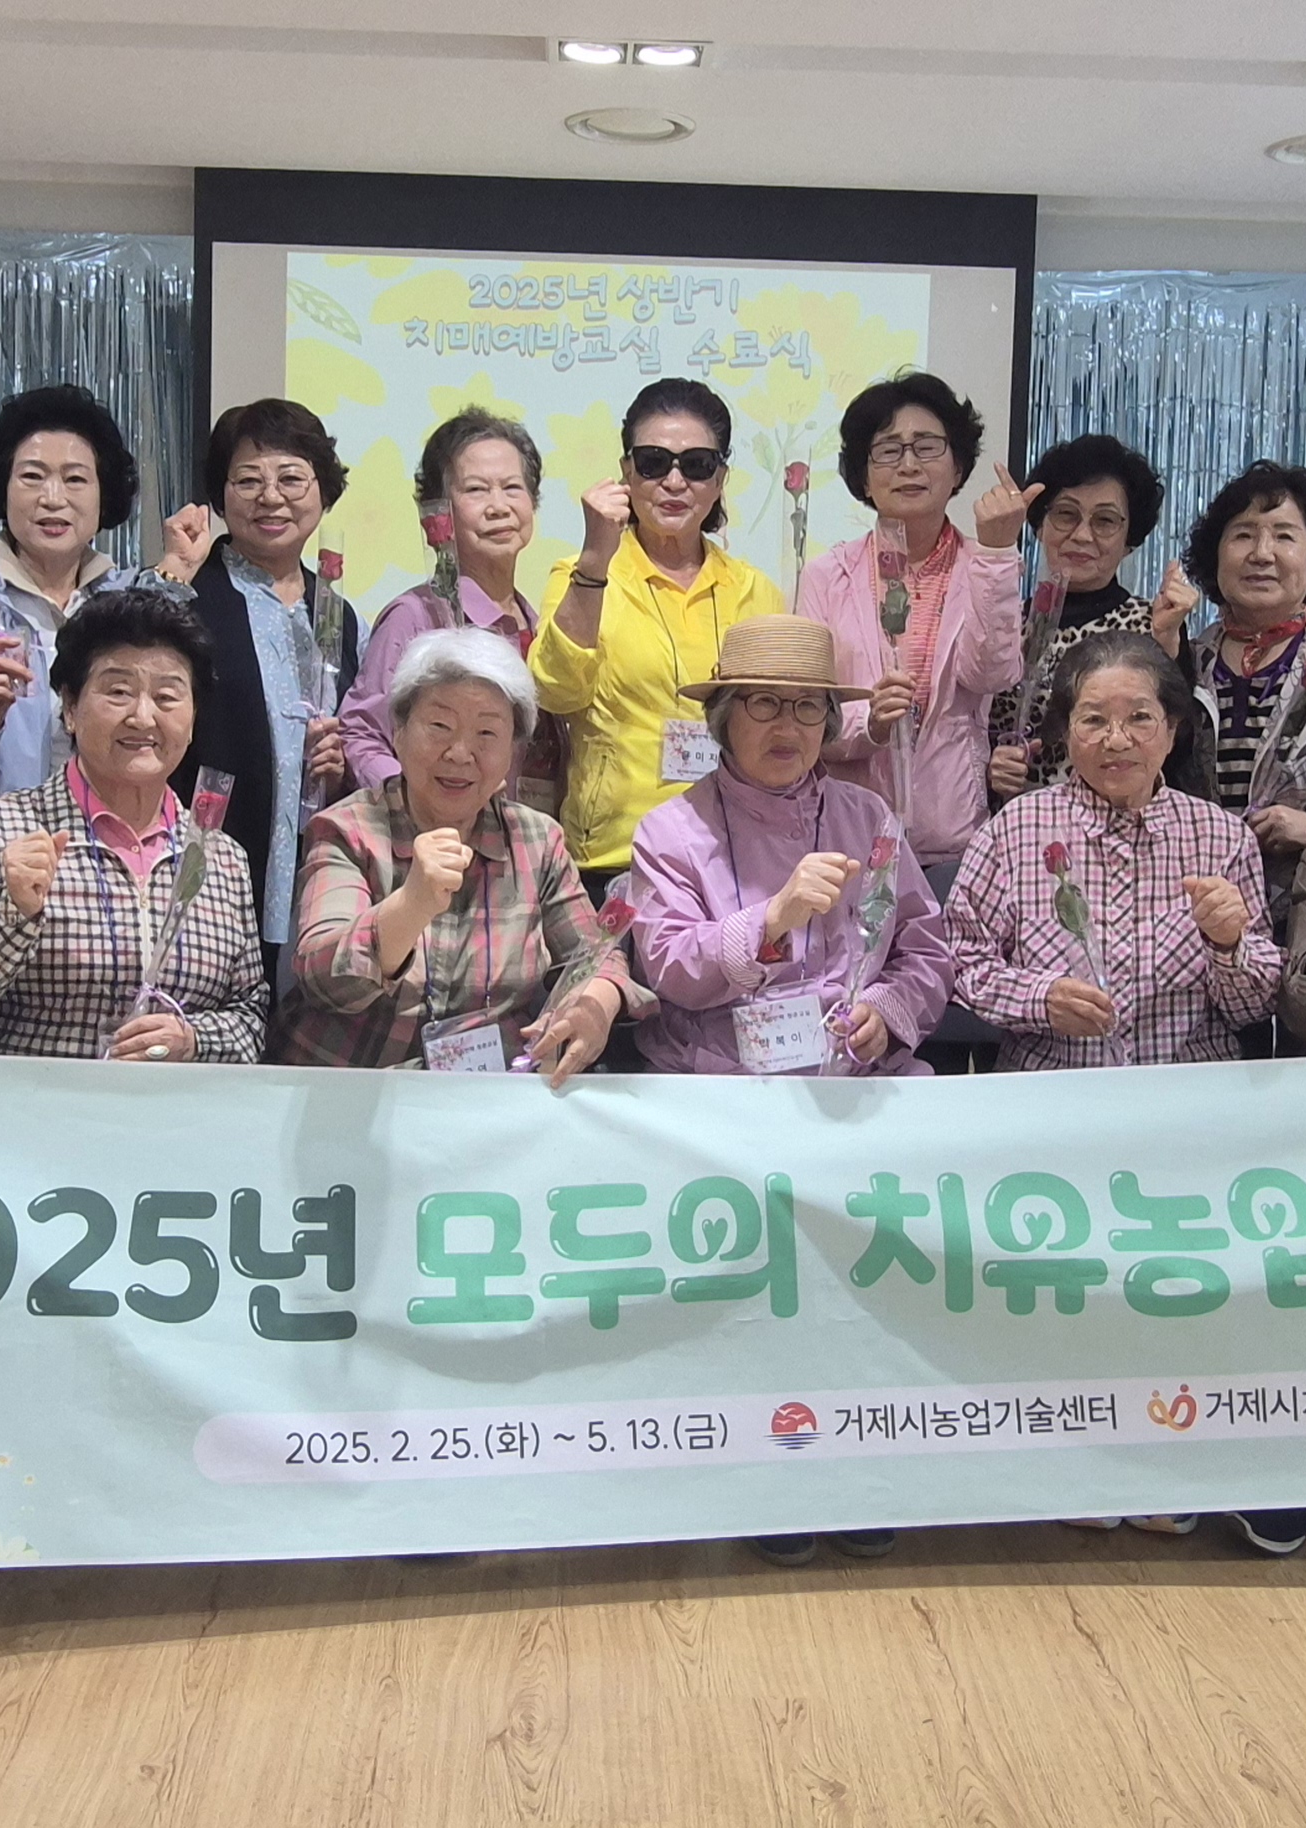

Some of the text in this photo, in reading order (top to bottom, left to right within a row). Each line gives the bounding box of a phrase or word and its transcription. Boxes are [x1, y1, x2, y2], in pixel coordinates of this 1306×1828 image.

[468, 273, 739, 323] 2025년 상반기
[403, 315, 812, 379] 치매예방교실 수료식
[406, 1171, 799, 1330] 모두의
[285, 1431, 379, 1465] 2025.
[390, 1429, 418, 1462] 2.
[429, 1421, 541, 1460] 25.(화)
[587, 1420, 616, 1453] 5.
[625, 1412, 729, 1451] 13.(금)
[834, 1392, 1118, 1442] 거제시농업기술센터
